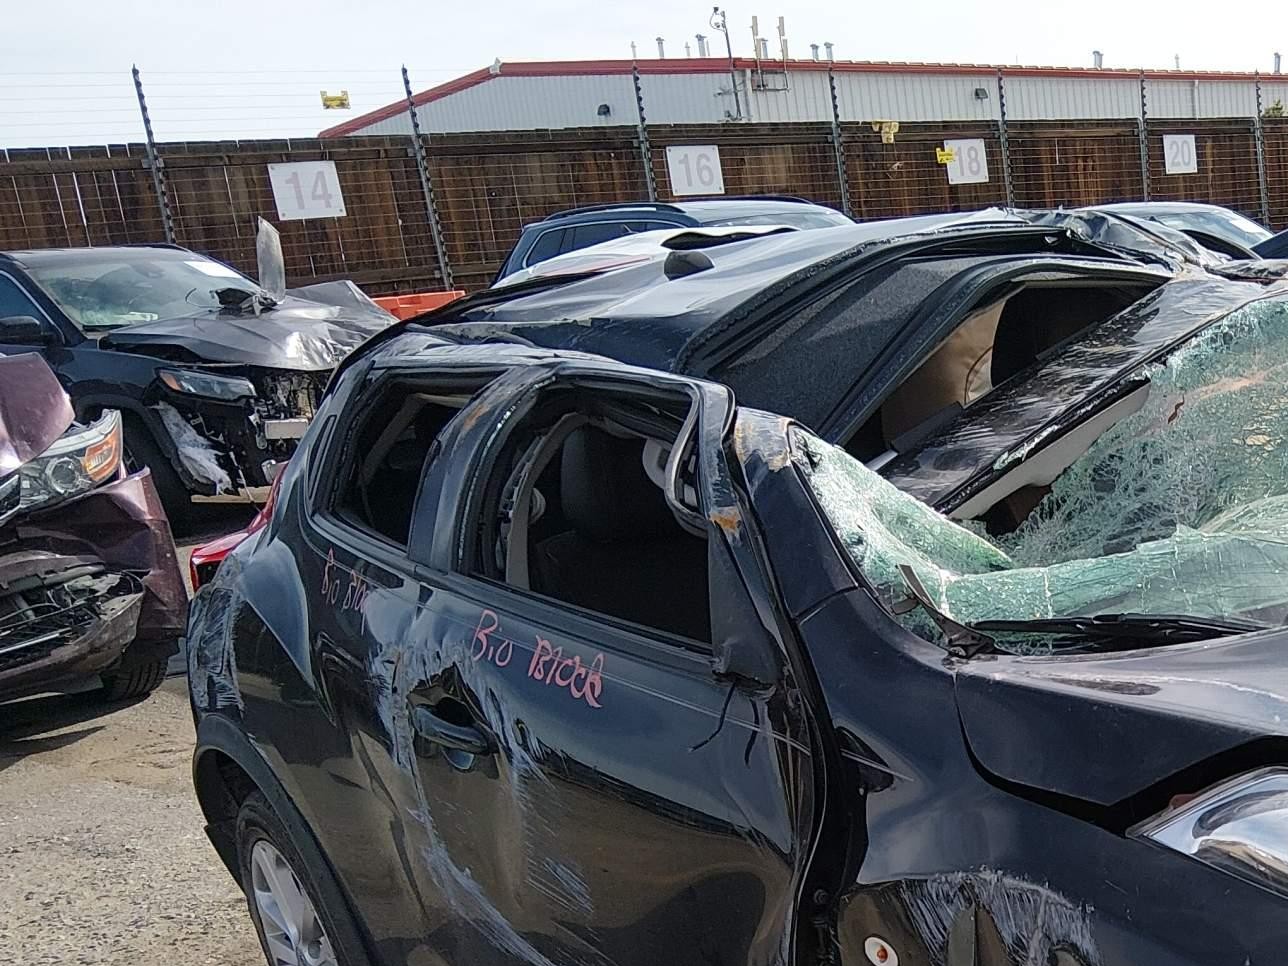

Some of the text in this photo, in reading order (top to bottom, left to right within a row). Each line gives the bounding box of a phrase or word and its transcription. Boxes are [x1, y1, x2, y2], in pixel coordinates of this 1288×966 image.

[678, 152, 714, 187] 16
[955, 145, 981, 177] 18
[1169, 140, 1191, 168] 20
[284, 170, 333, 210] 14
[470, 609, 512, 667] Bio
